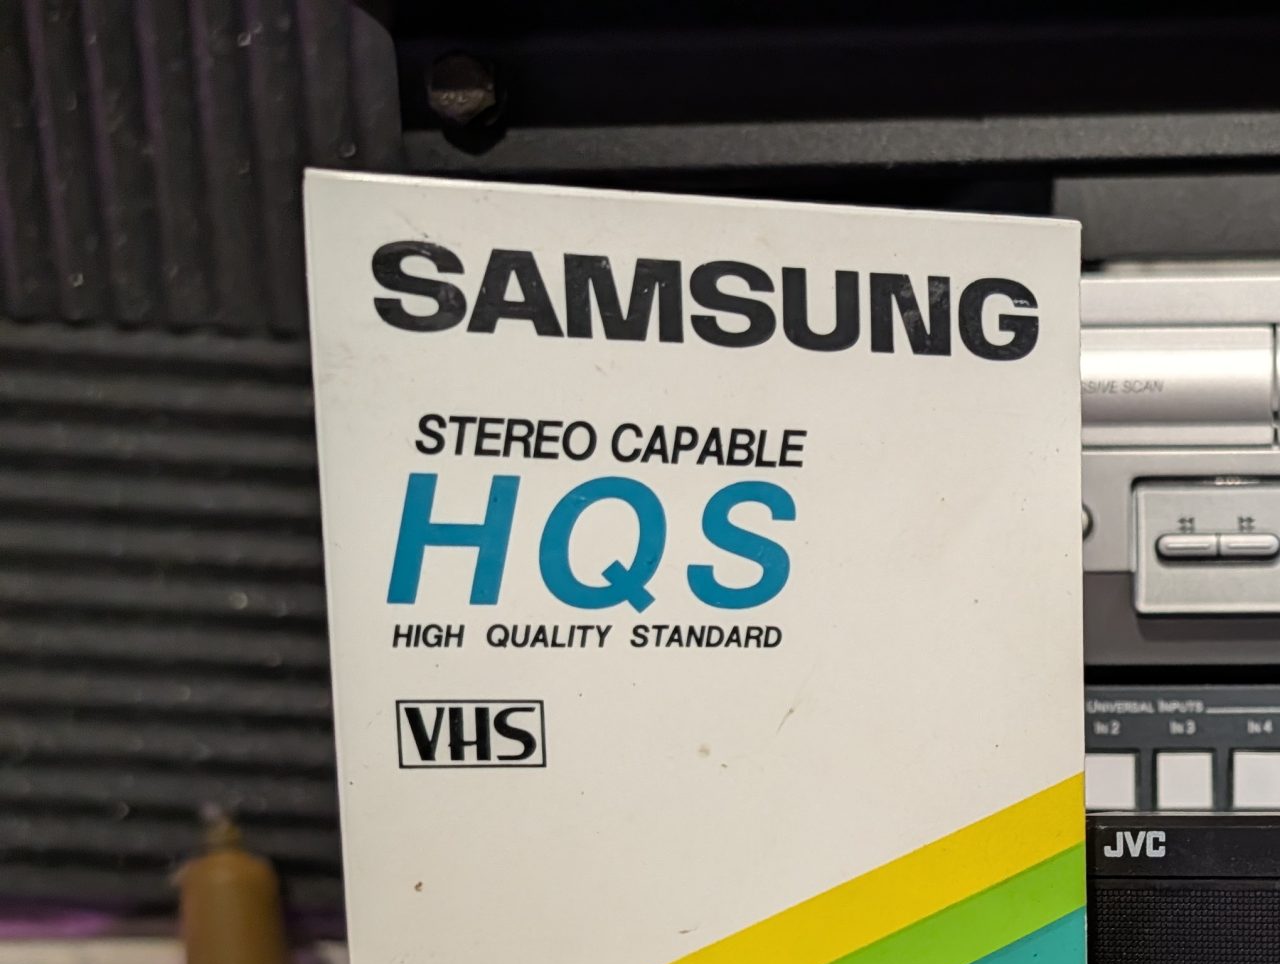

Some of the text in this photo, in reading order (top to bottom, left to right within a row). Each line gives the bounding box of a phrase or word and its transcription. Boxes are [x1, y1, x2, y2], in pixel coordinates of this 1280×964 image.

[371, 240, 1040, 361] SAMSUNG
[1122, 380, 1164, 393] SCAN
[415, 413, 807, 468] STEREO CAPABLE
[386, 473, 797, 613] HQS
[392, 624, 783, 649] HIGH QUALITY STANDARD
[403, 706, 538, 762] VHS
[1185, 719, 1196, 734] 3
[1262, 719, 1273, 733] 4
[1103, 831, 1166, 858] JVC
